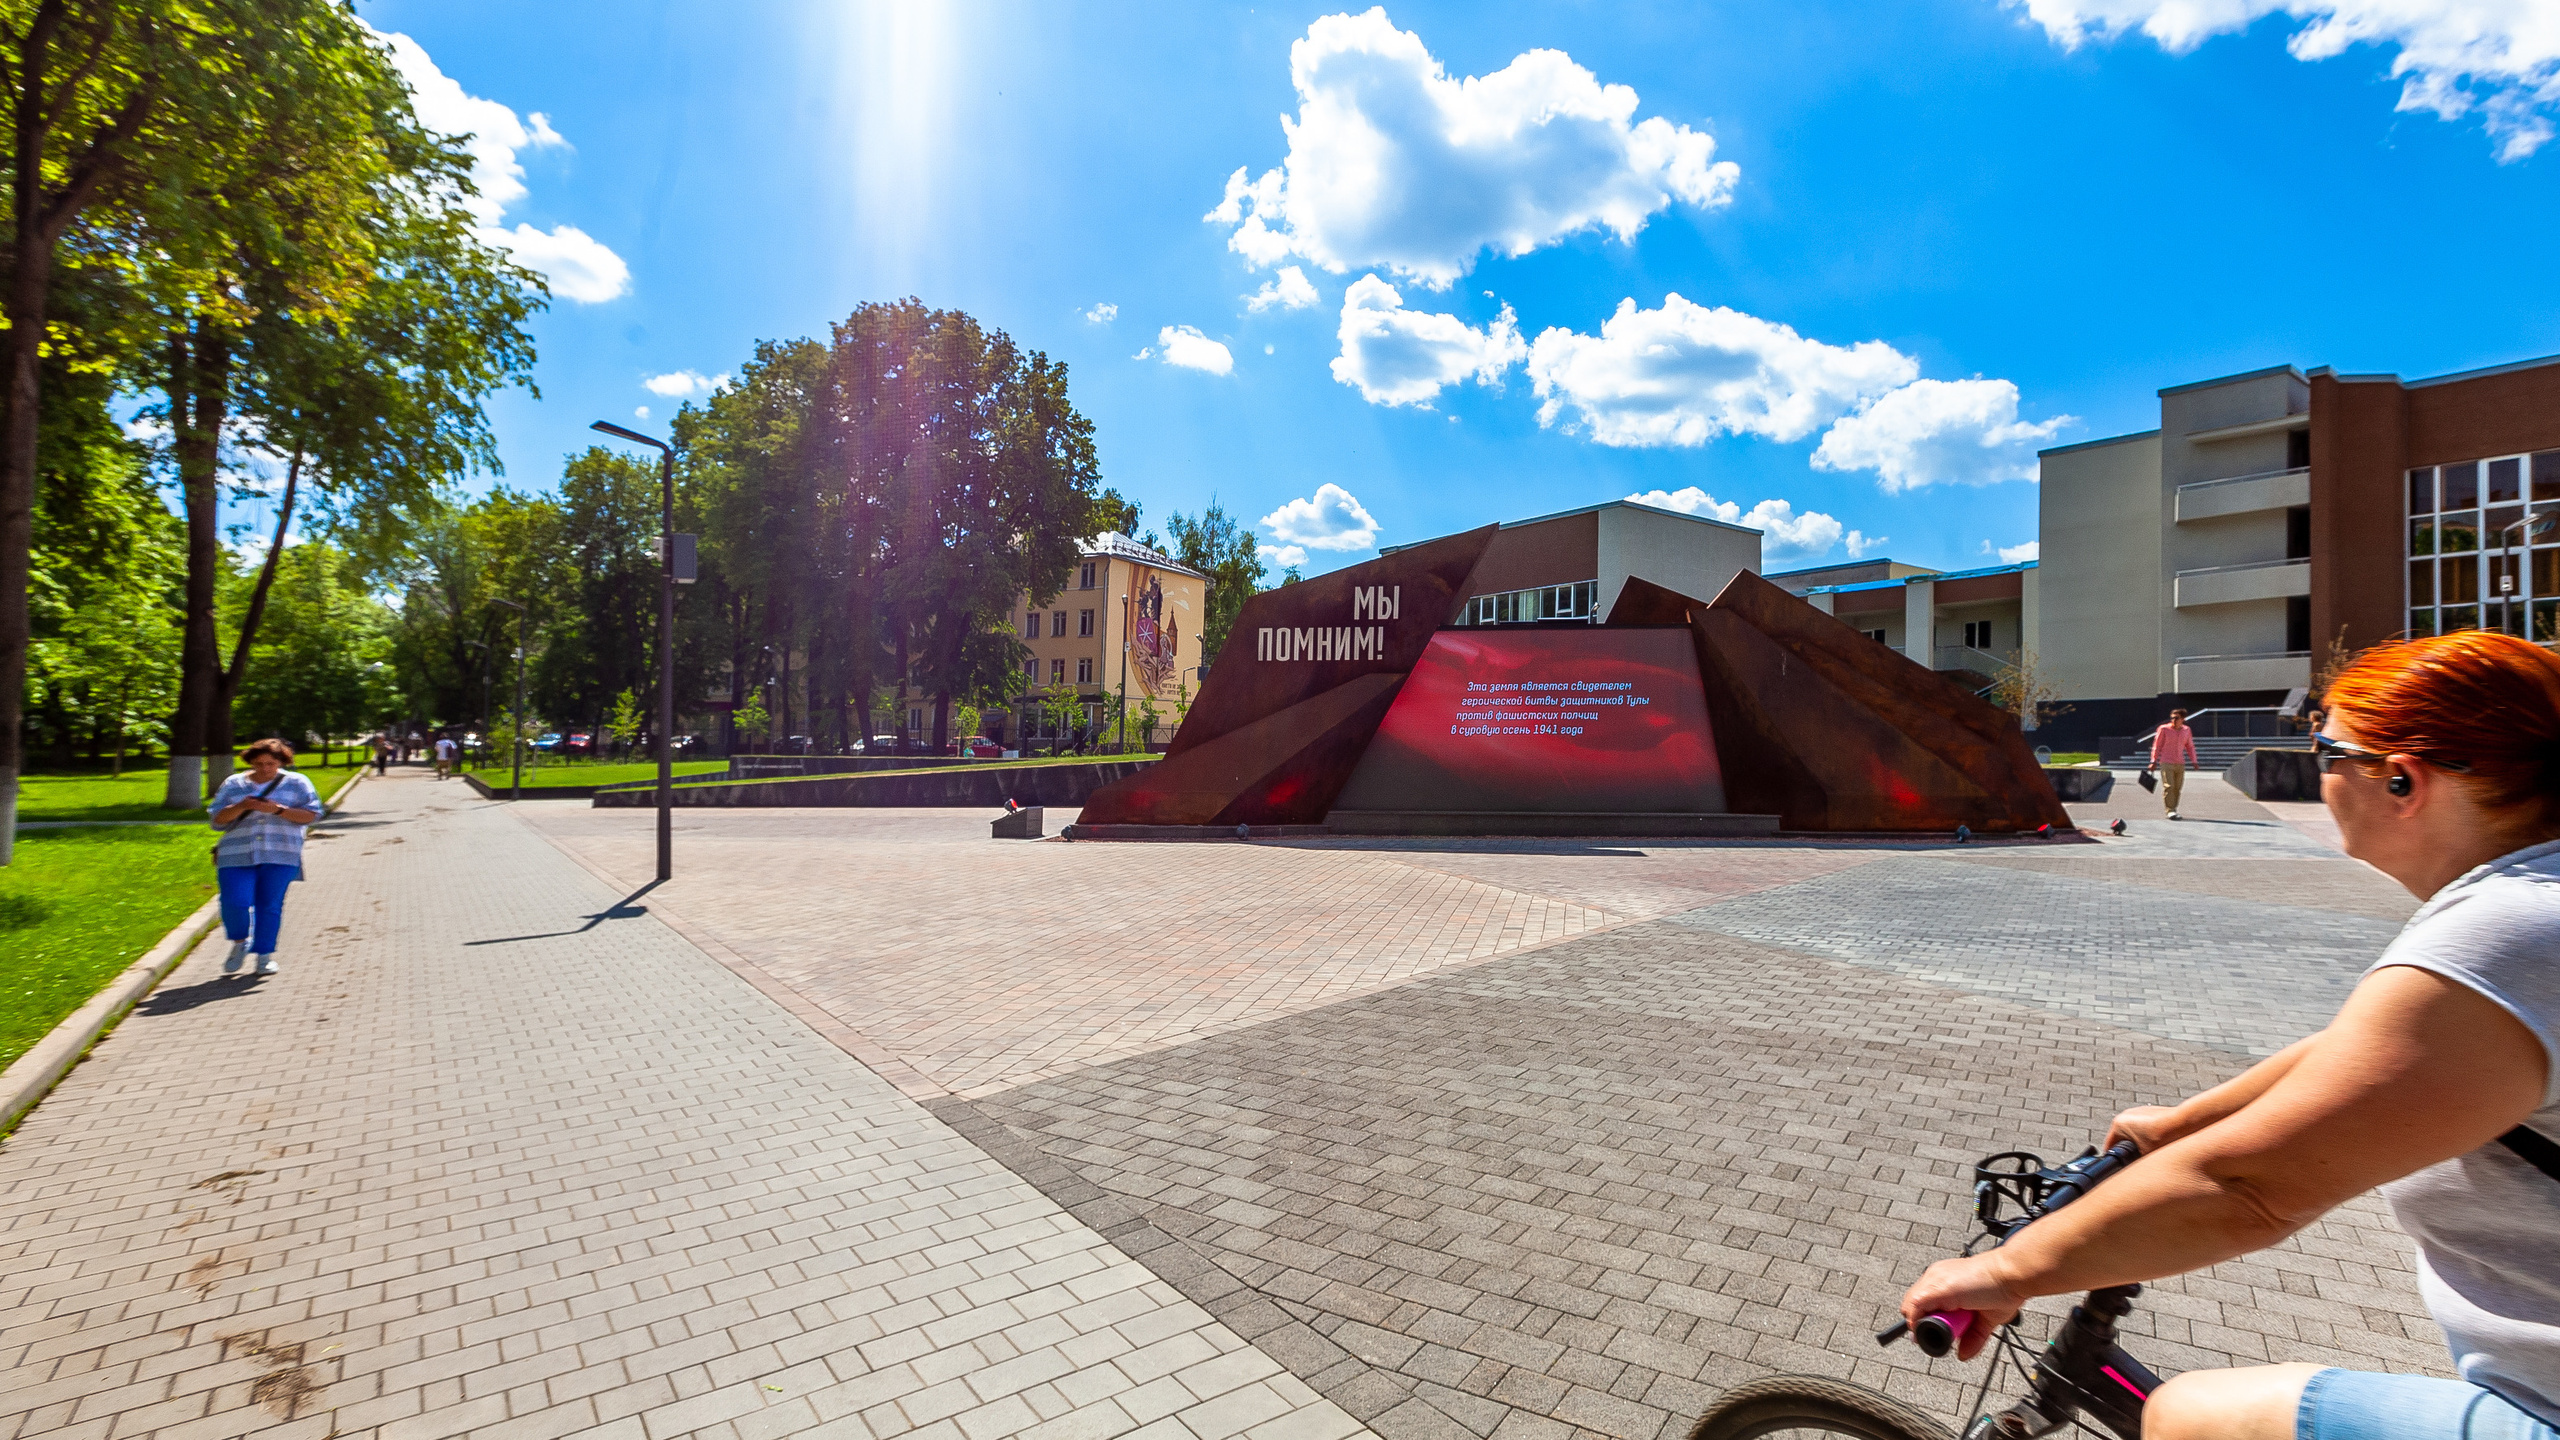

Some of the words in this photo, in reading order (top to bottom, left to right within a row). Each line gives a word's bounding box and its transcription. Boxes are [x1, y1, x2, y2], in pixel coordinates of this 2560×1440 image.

[1354, 585, 1400, 620] МЫ
[1257, 626, 1384, 662] ПОМНИМ!
[1467, 681, 1487, 691] Эта
[1489, 682, 1519, 693] земля
[1521, 681, 1569, 691] является
[1570, 680, 1632, 693] свидетелем
[1461, 695, 1523, 708] героической
[1524, 695, 1559, 706] битвы
[1560, 694, 1624, 708] защитников
[1626, 694, 1650, 707] Тулы
[1455, 710, 1494, 722] против
[1495, 710, 1559, 722] фашистских
[1560, 711, 1599, 721] полчищ
[1450, 724, 1457, 735] в
[1459, 724, 1501, 737] суровую
[1502, 726, 1531, 735] осень
[1533, 724, 1558, 735] 1941
[1560, 725, 1584, 737] года
